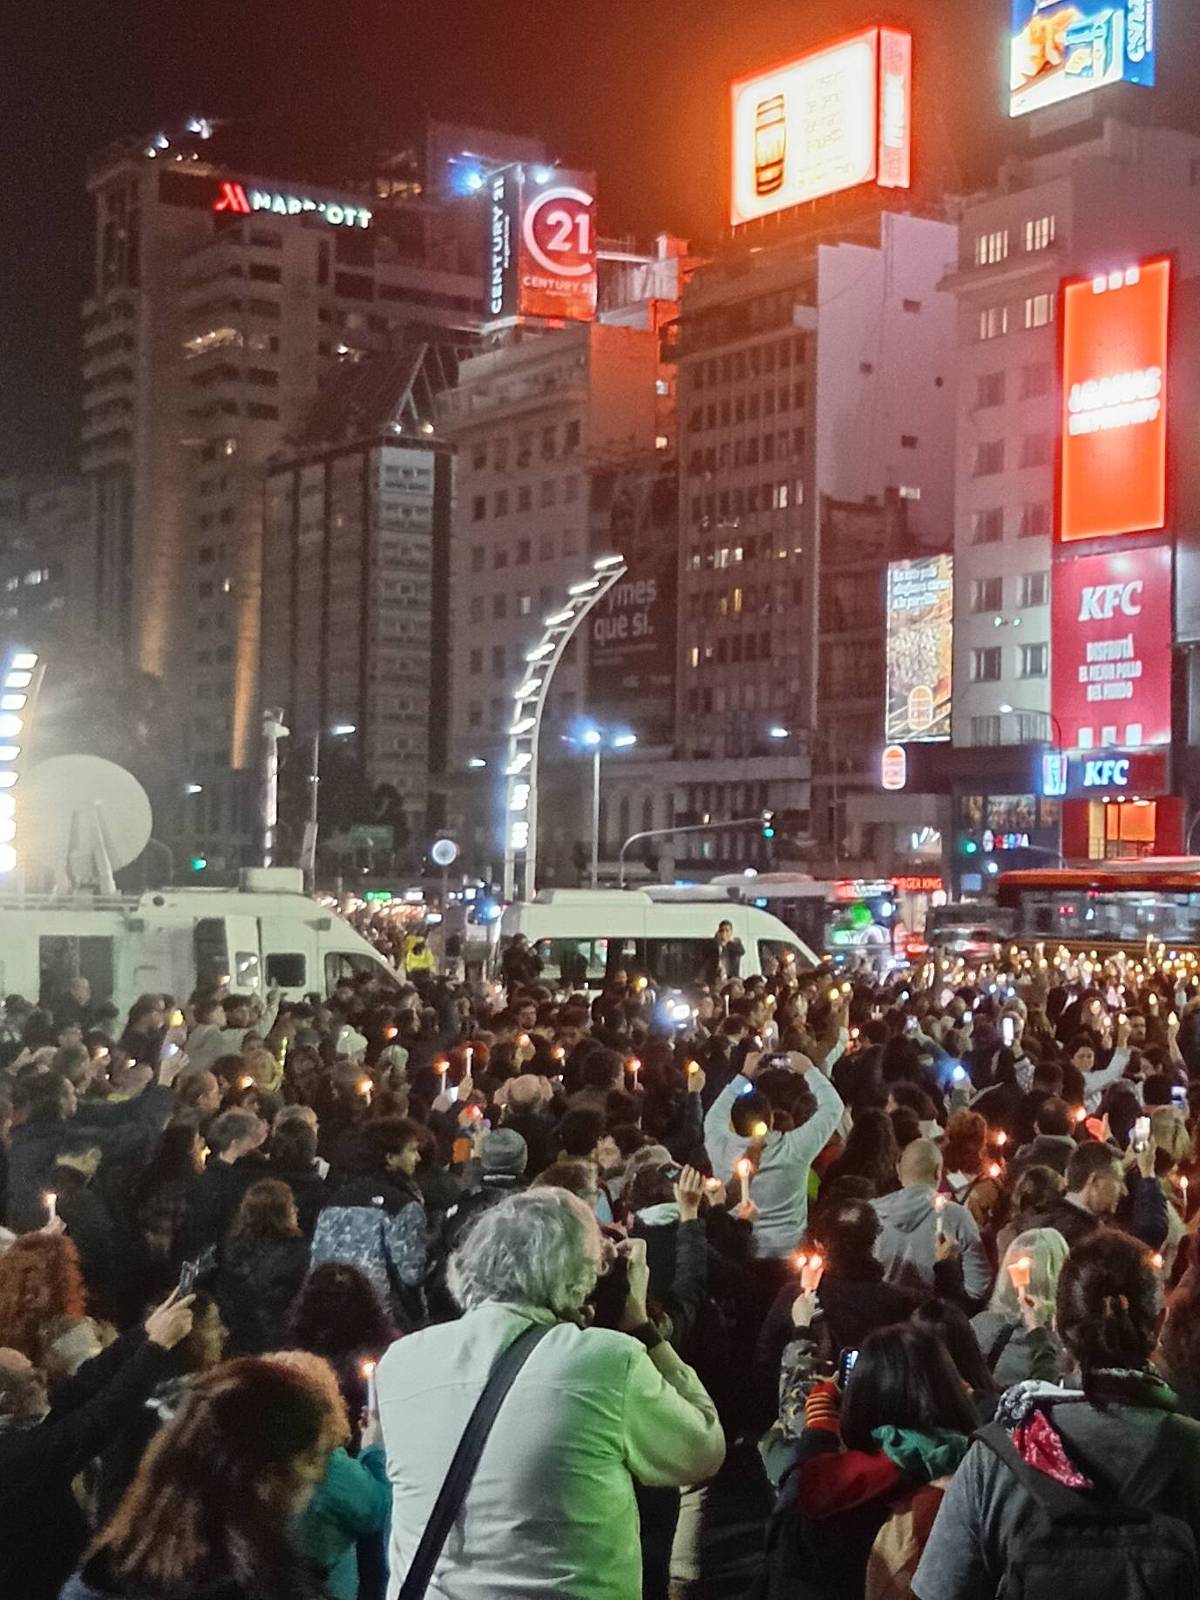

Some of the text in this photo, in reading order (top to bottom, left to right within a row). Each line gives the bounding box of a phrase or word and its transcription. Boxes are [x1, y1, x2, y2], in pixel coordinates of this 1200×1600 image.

[252, 190, 373, 229] MAROTT
[491, 175, 504, 314] CENTURY 21
[523, 275, 579, 293] CENTURY
[608, 580, 656, 613] ymes
[1078, 580, 1143, 621] KFC
[594, 615, 628, 647] que
[1083, 759, 1130, 786] KFC
